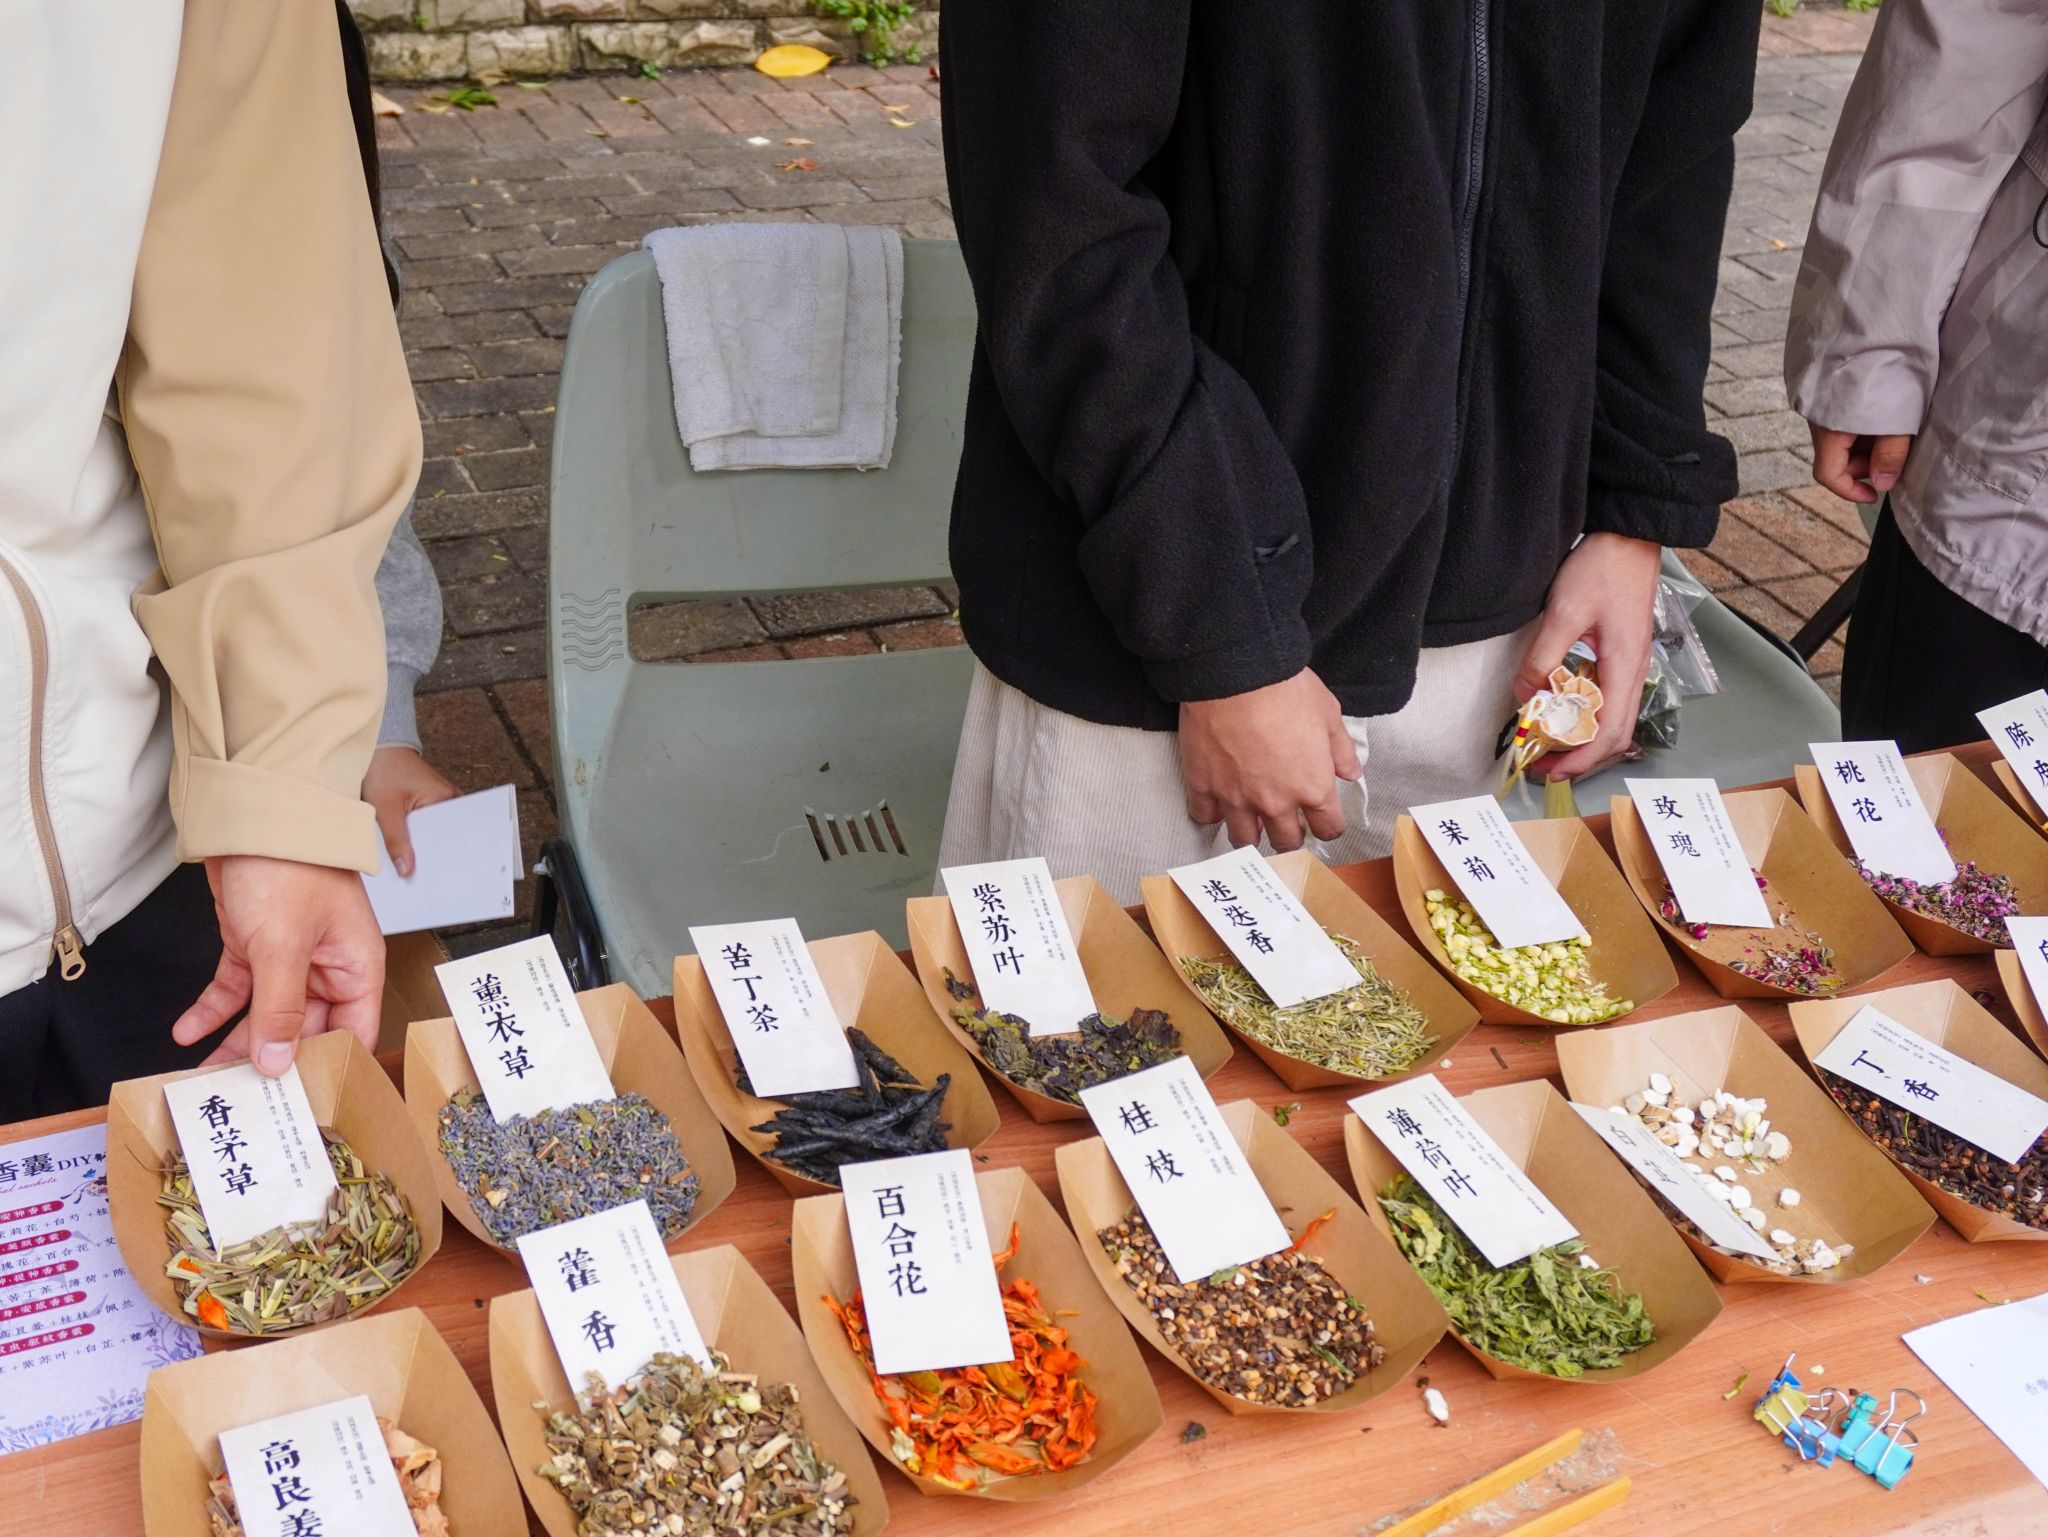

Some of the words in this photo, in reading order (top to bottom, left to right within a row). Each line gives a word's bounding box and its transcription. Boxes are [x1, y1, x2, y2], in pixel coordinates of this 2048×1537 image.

[1651, 795, 1701, 858] 玫瑰
[1834, 760, 1883, 823] 桃花
[1438, 819, 1495, 882] 茉莉
[972, 882, 1025, 976] 紫苏叶
[1201, 879, 1275, 955] 迷迭香
[469, 973, 535, 1080] 薰衣草
[721, 942, 779, 1032] 苦丁茶
[1850, 1050, 1940, 1102] 丁香
[199, 1095, 258, 1196] 香茅草
[1118, 1100, 1185, 1184] 桂枝
[1385, 1107, 1478, 1199] 薄荷叶
[872, 1185, 928, 1297] 百合花
[557, 1247, 617, 1354] 藿香
[258, 1439, 323, 1537] 高良姜
